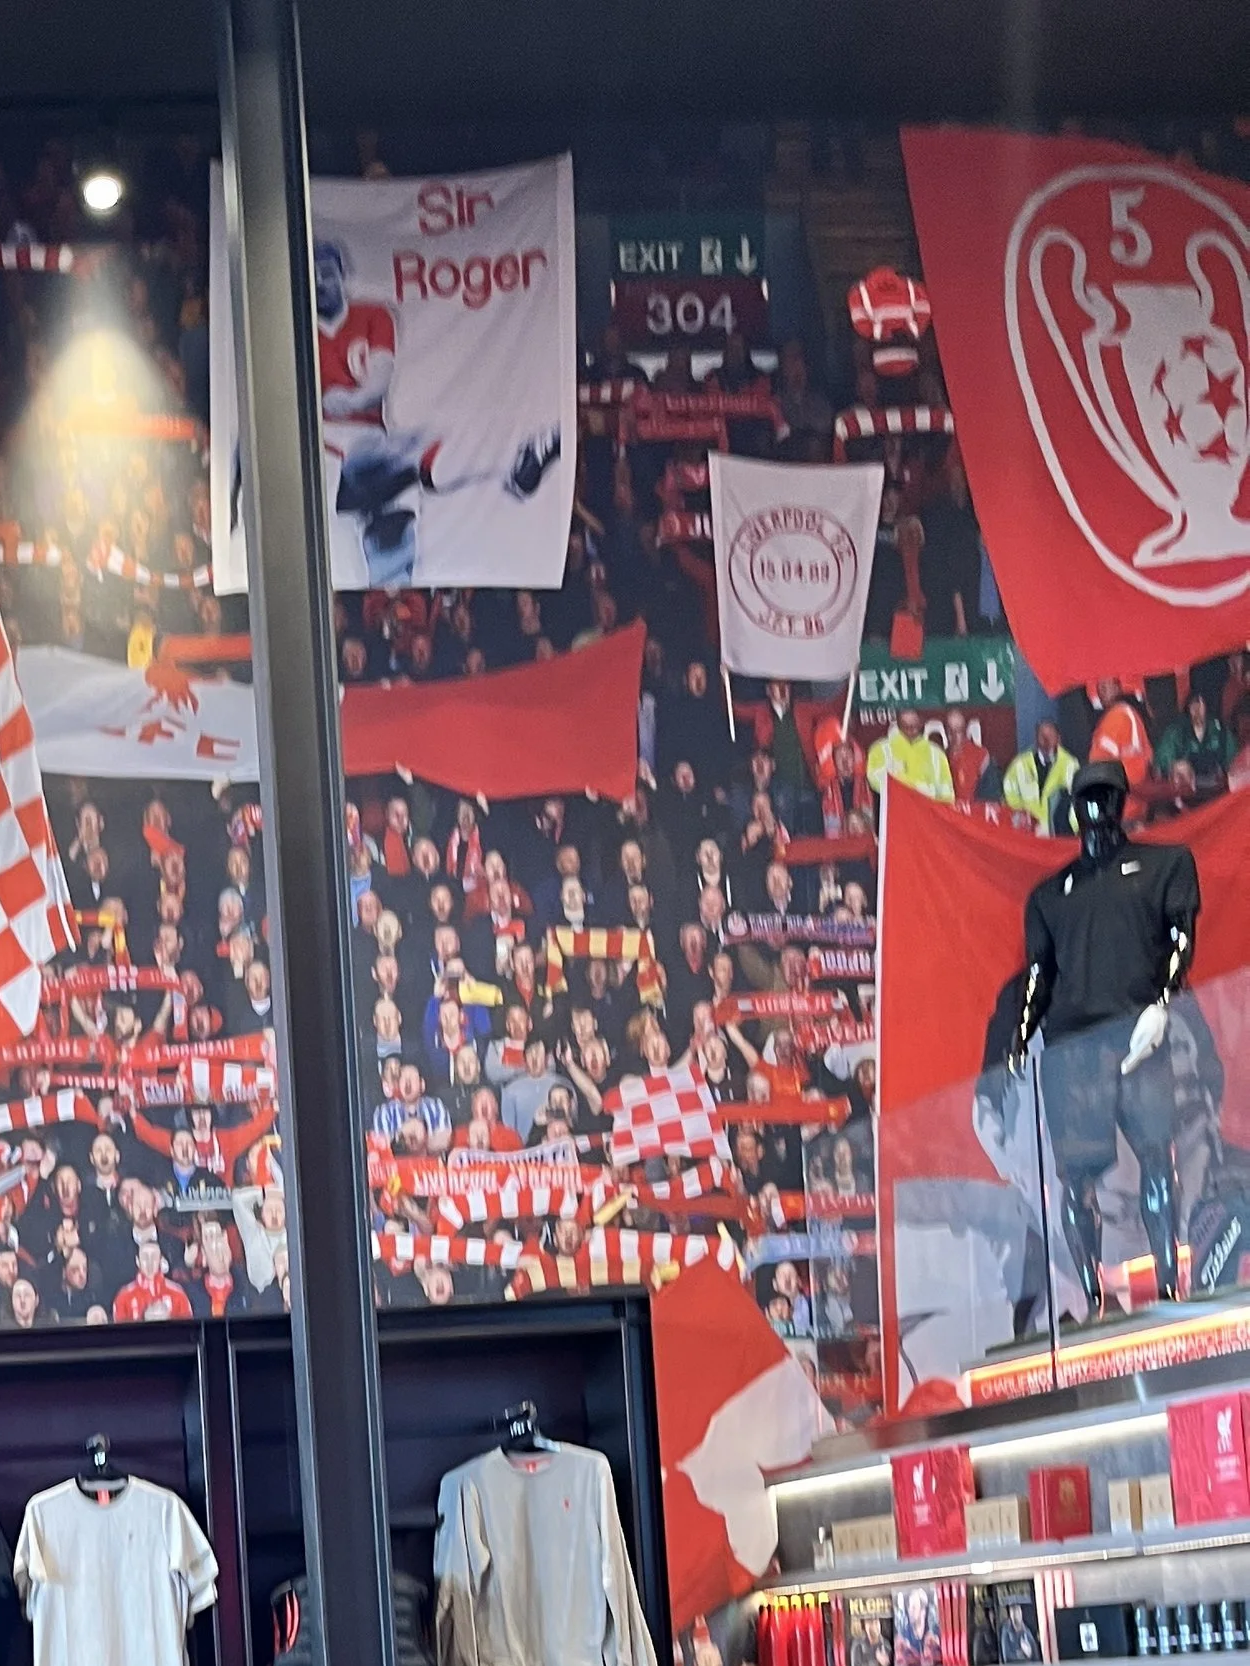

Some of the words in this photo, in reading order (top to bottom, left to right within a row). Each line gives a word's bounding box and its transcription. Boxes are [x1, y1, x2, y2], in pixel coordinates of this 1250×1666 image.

[417, 180, 495, 237] Sir
[1110, 185, 1153, 268] 5
[392, 247, 548, 310] Roger
[619, 240, 683, 273] EXIT
[647, 292, 734, 334] 304
[859, 667, 929, 701] EXIT
